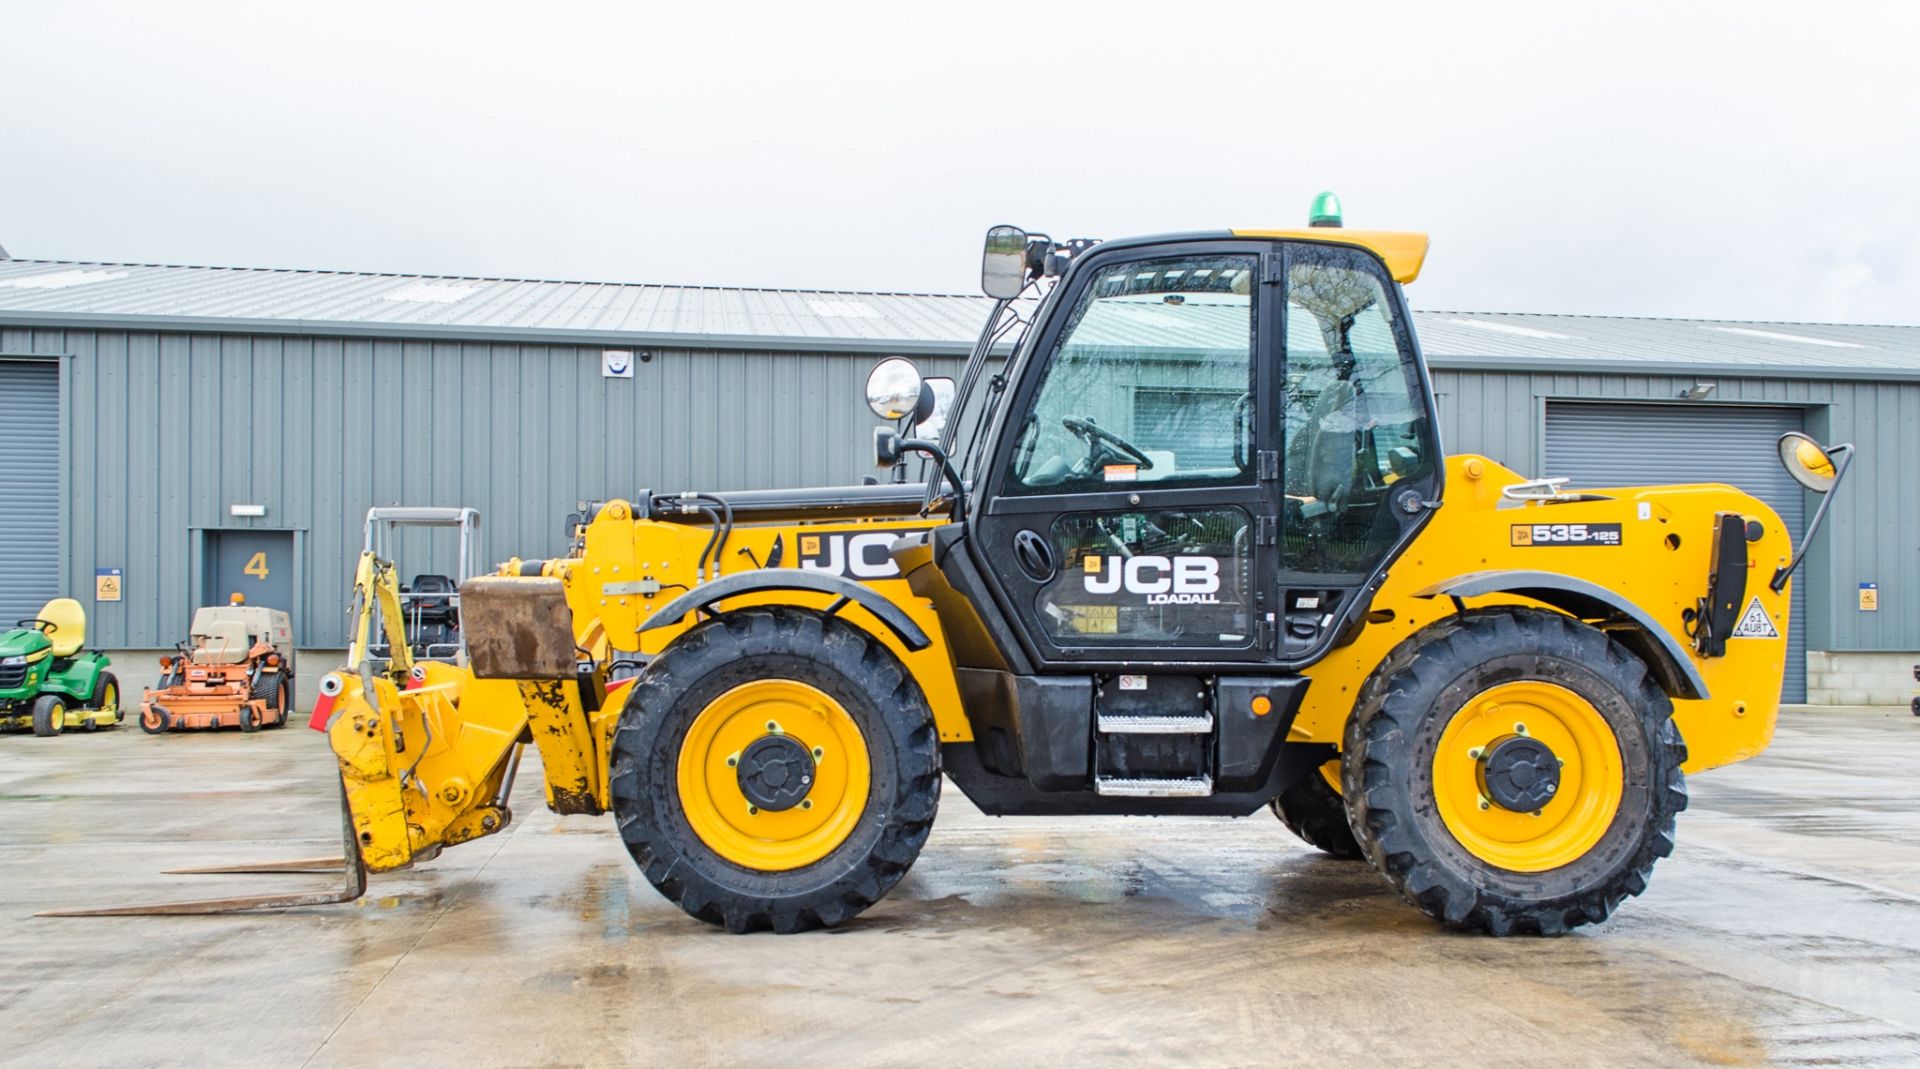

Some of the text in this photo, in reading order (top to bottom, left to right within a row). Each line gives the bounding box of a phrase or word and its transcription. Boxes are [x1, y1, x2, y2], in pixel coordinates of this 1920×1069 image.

[1532, 525, 1619, 541] 535-125
[244, 552, 269, 580] 4
[801, 532, 929, 577] JC
[1084, 555, 1220, 594] JCB
[1147, 594, 1220, 605] LOADALL
